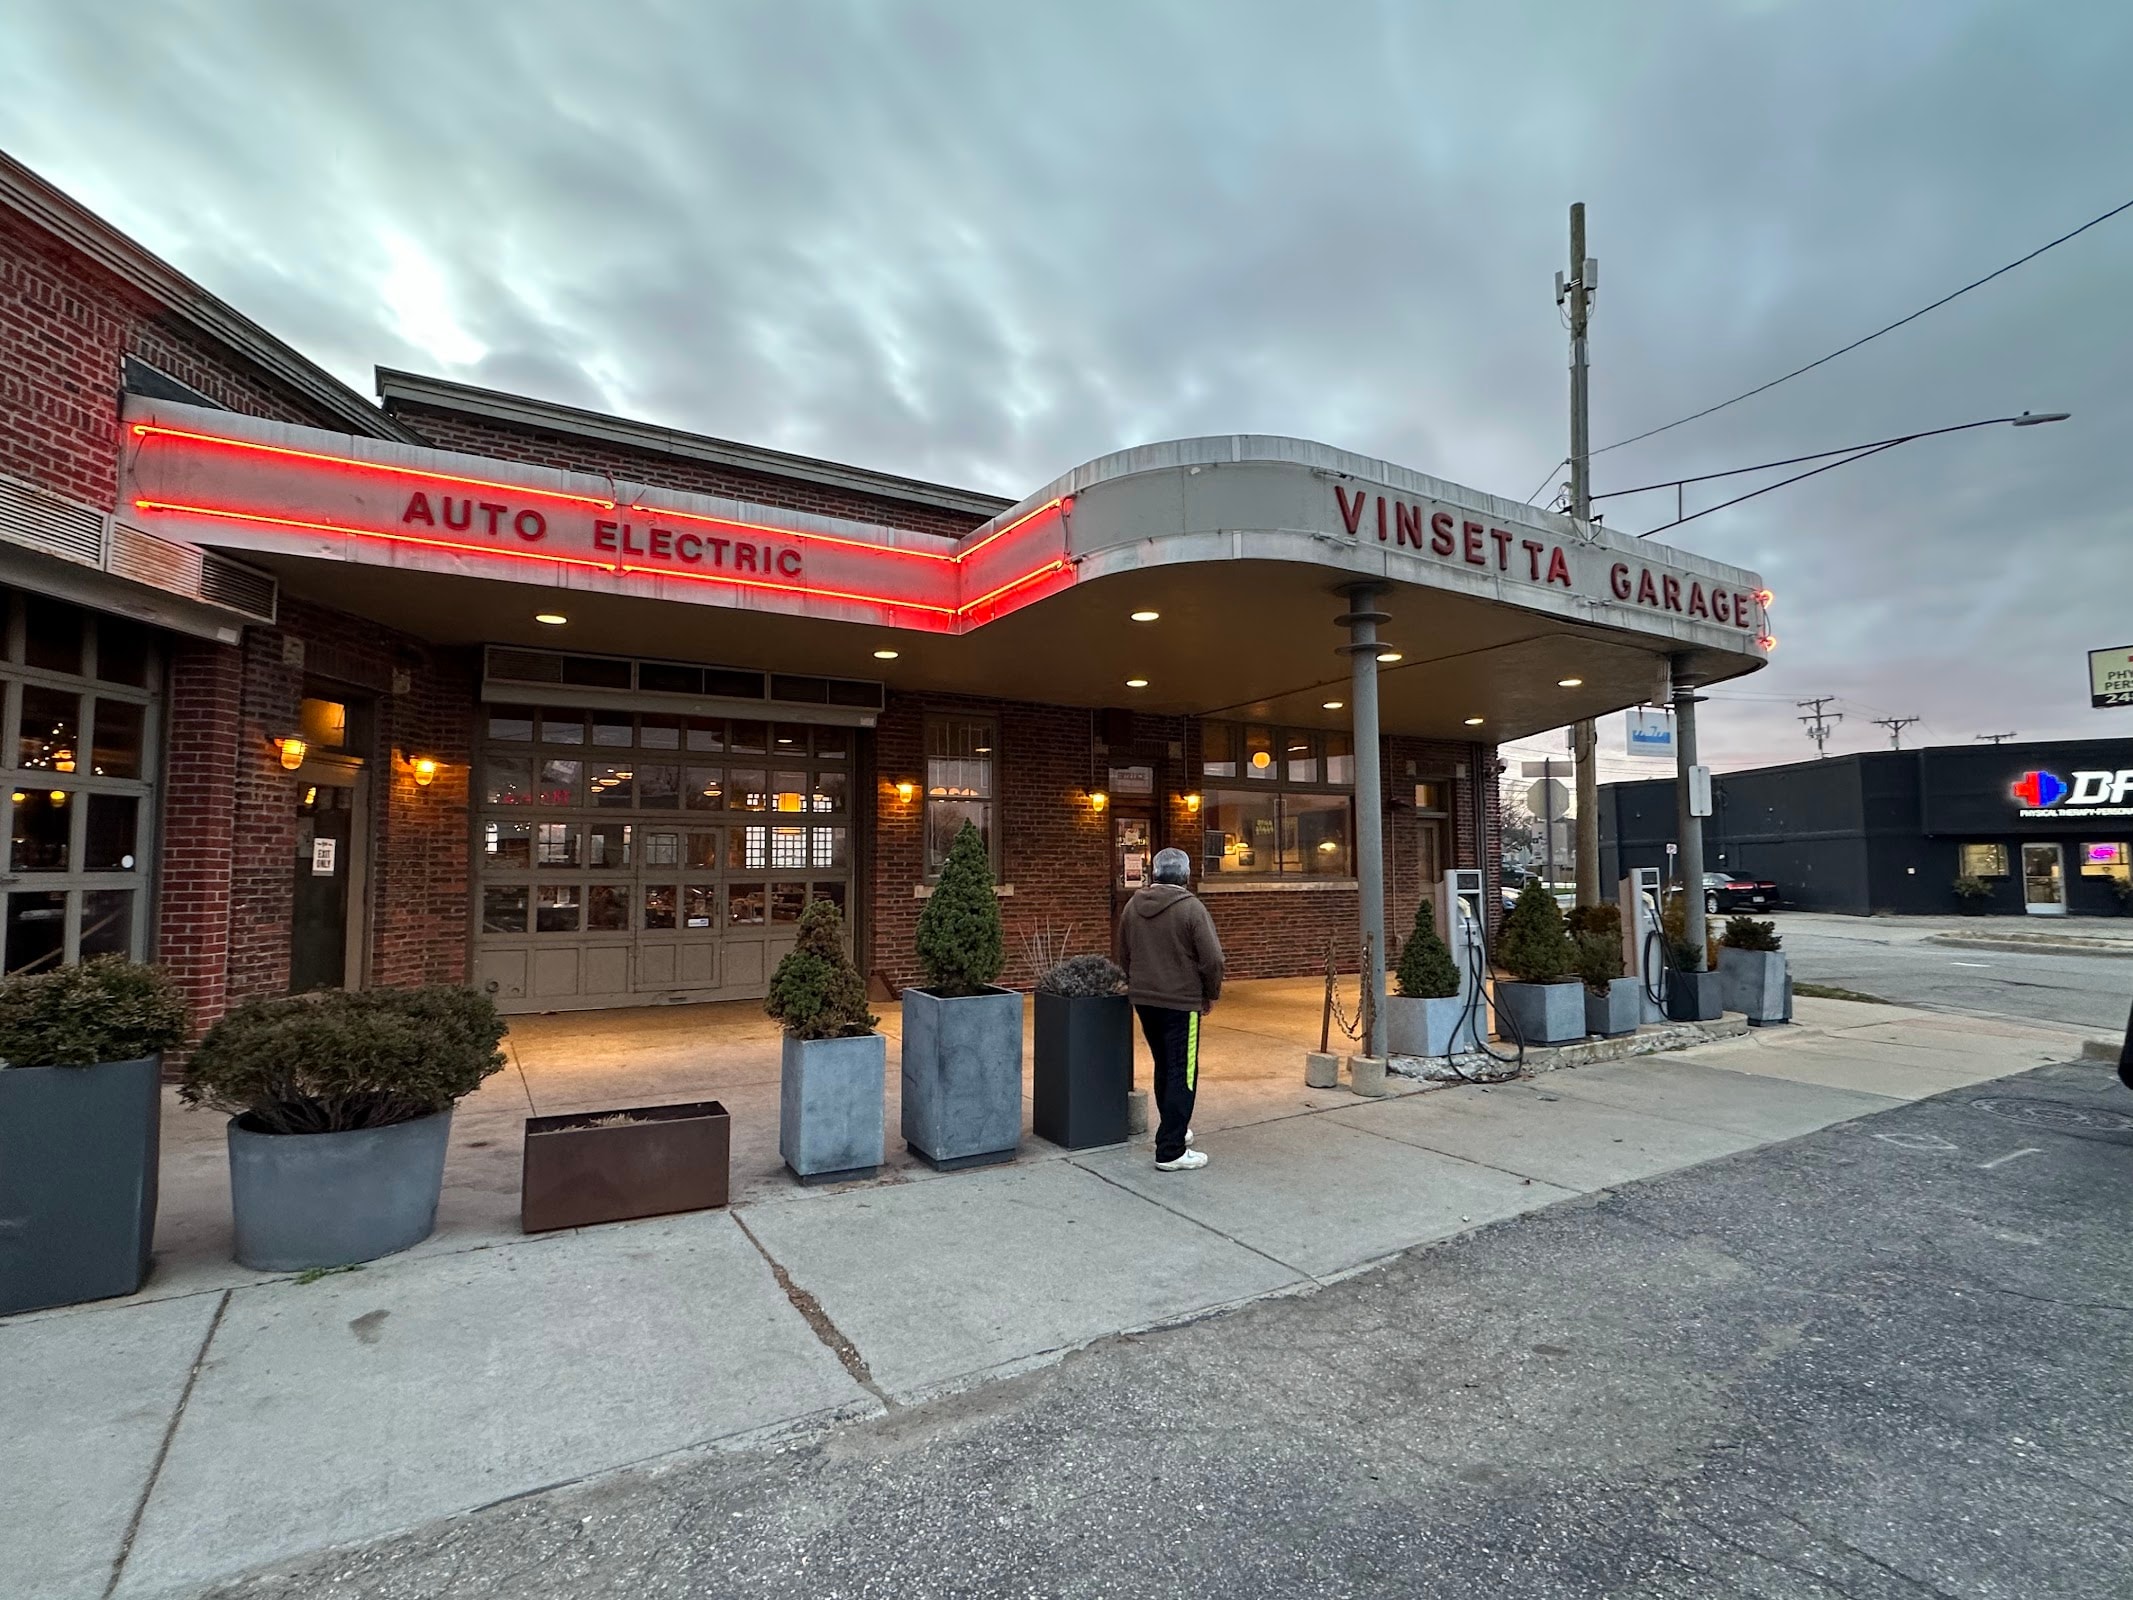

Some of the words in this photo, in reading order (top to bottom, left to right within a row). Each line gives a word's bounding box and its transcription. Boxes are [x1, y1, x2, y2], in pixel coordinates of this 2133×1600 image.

[402, 491, 546, 542] AUTO
[593, 519, 802, 578] ELECTRIC
[1334, 485, 1572, 587] VINSETTA
[1610, 562, 1750, 628] GARAGE
[316, 859, 331, 869] ONLY
[317, 849, 331, 859] EXIT
